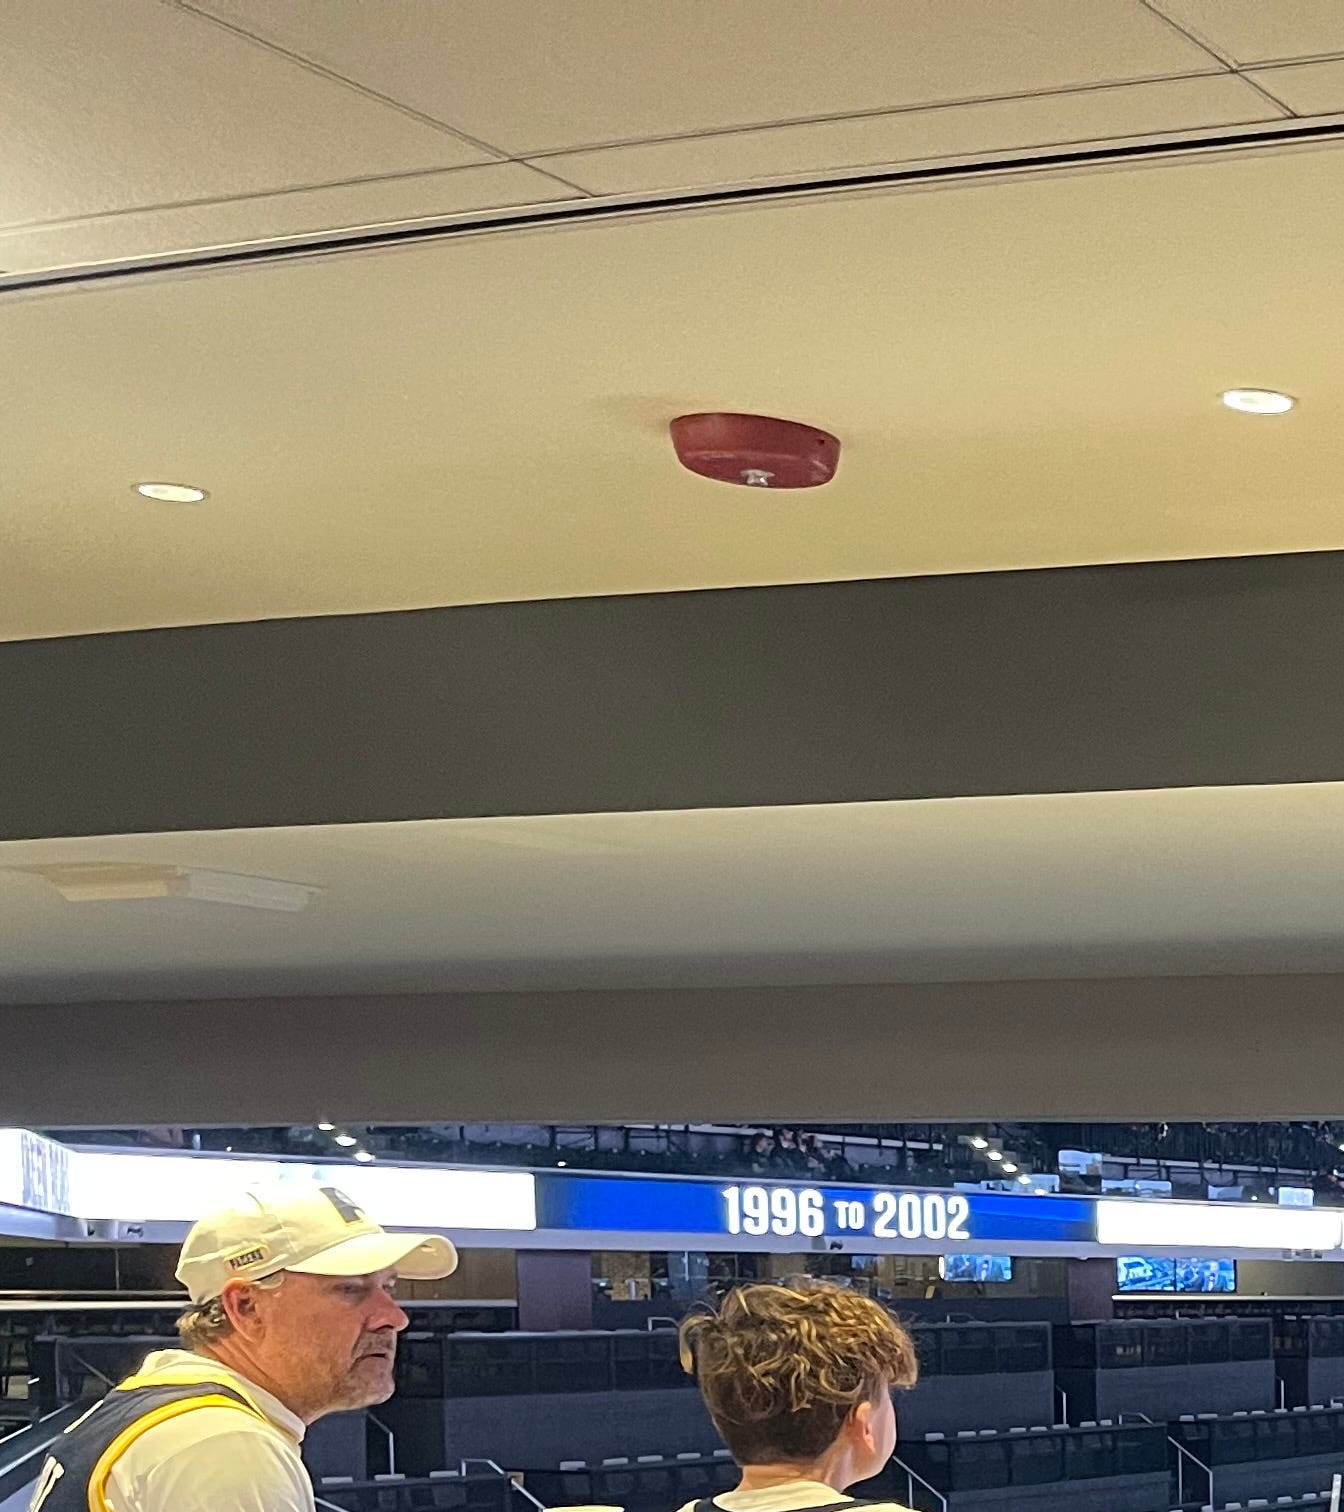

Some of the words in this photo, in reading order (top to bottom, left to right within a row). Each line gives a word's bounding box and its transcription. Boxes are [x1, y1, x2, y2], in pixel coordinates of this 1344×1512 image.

[722, 1185, 825, 1237] 1996
[834, 1200, 865, 1229] TO
[872, 1192, 970, 1240] 2002
